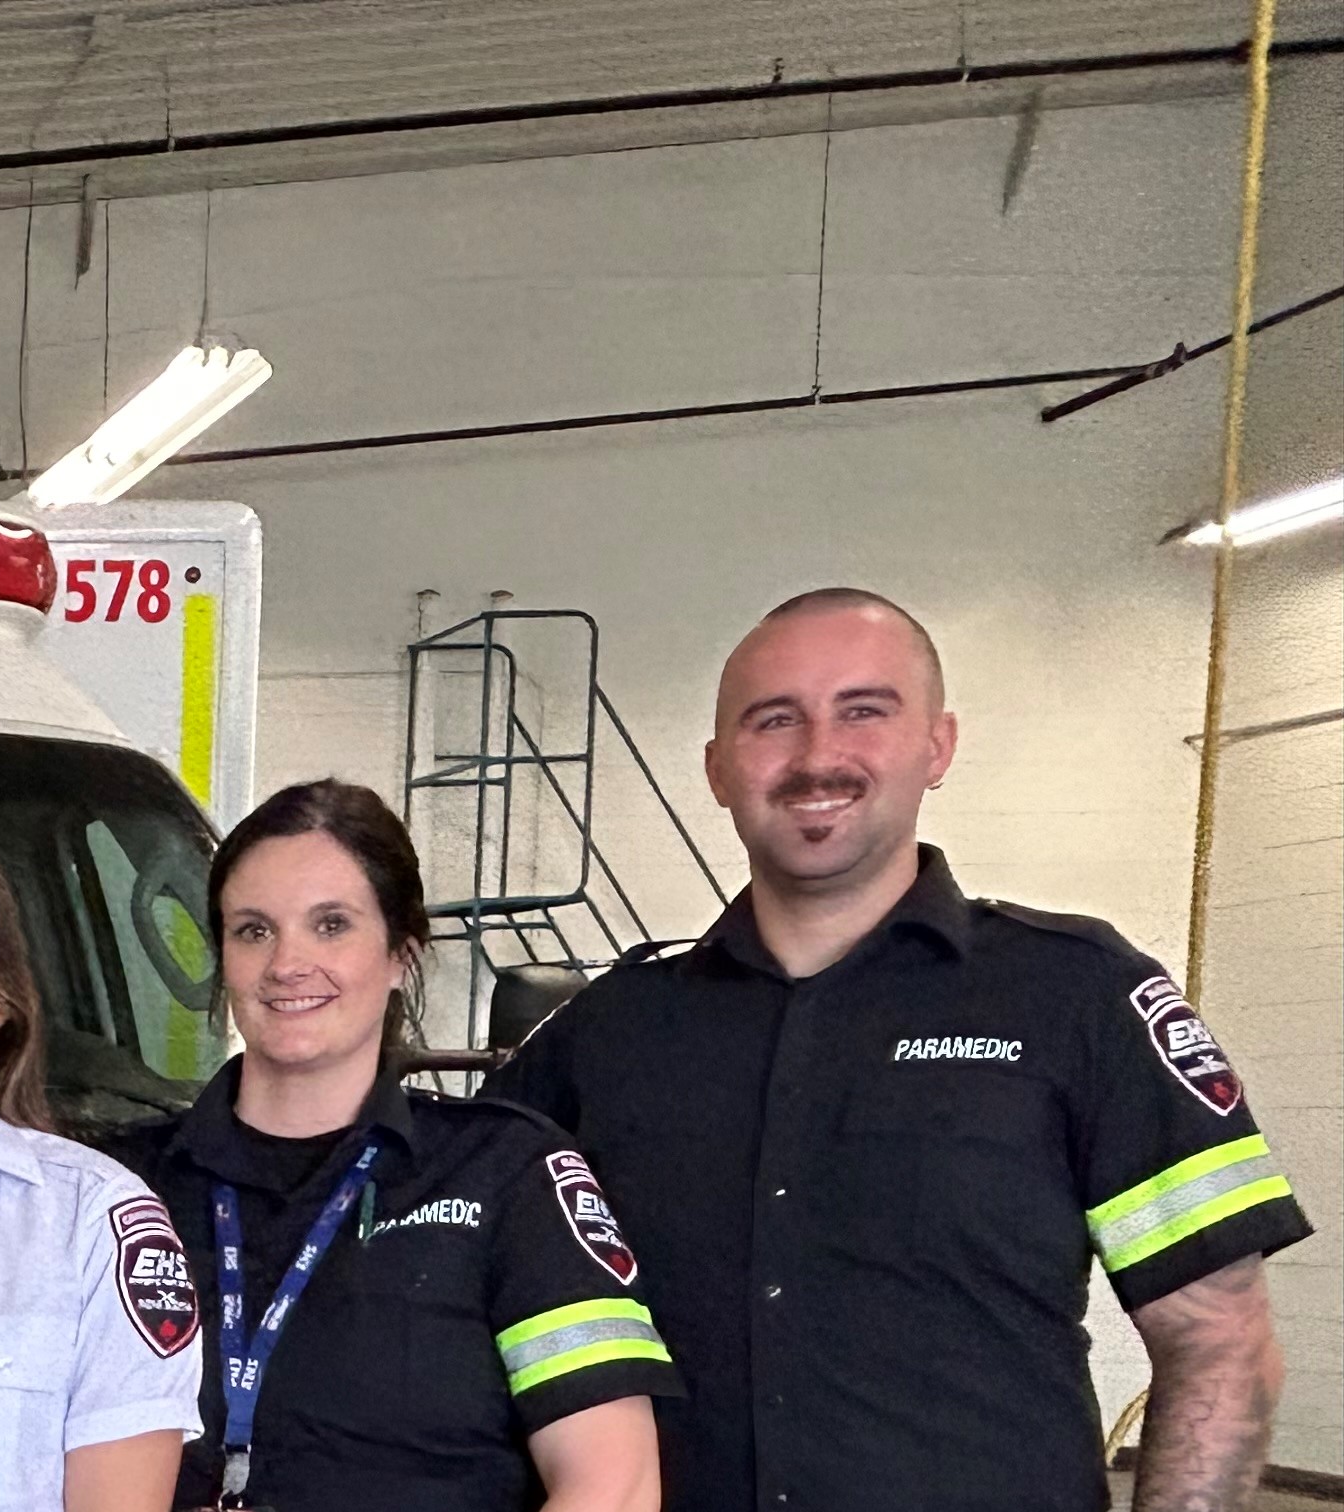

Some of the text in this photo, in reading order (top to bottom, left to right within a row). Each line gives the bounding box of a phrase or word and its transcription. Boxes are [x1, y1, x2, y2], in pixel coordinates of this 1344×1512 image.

[64, 558, 172, 624] 578
[894, 1036, 1023, 1062] PARAMEDIC
[130, 1246, 188, 1281] EHS
